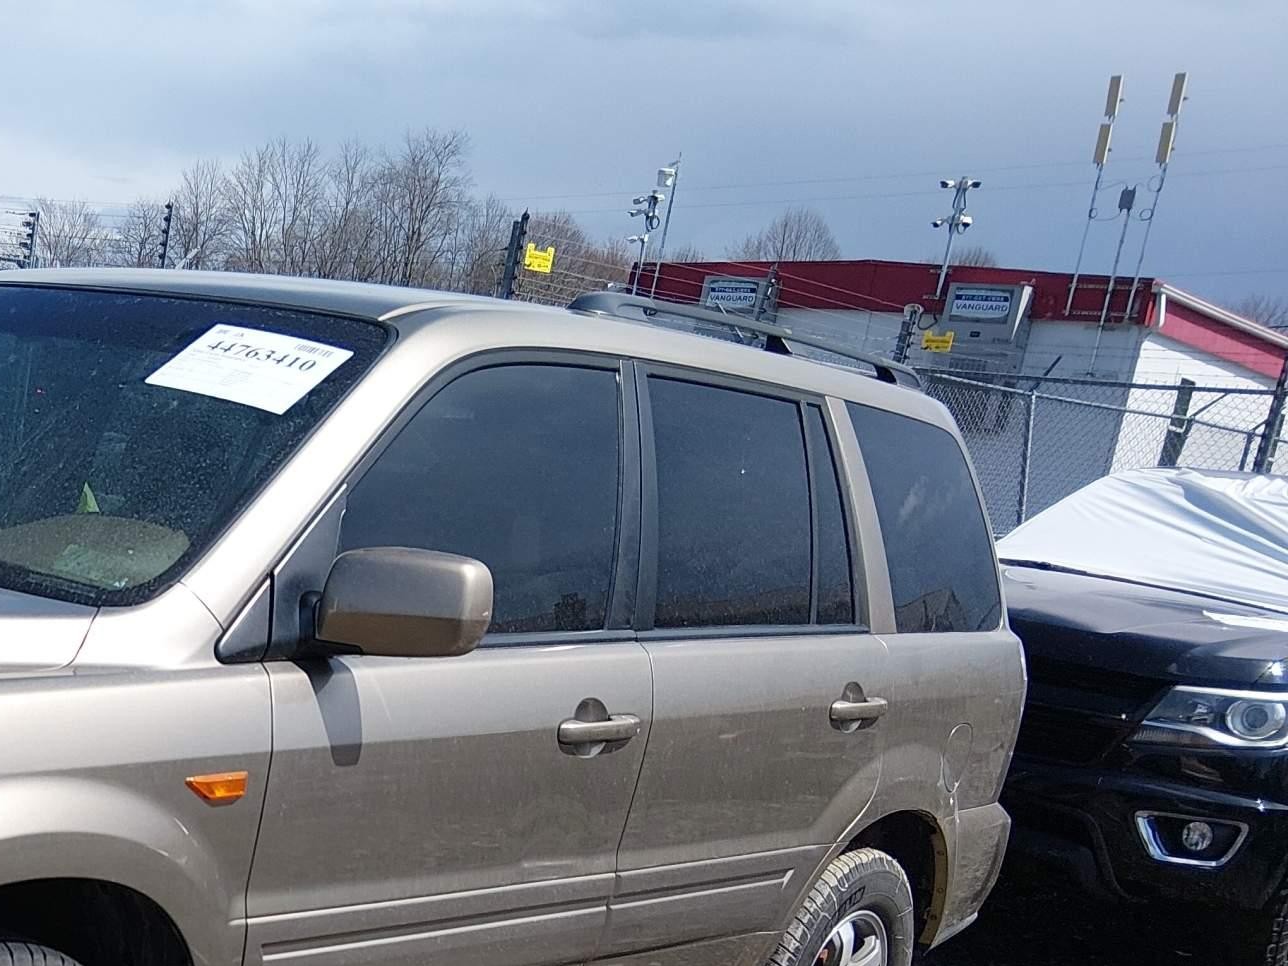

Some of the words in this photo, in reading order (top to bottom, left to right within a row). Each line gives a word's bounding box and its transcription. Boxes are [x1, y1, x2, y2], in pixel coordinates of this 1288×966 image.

[710, 294, 754, 302] VANGUARD
[955, 302, 1008, 312] VANGUARD
[207, 340, 316, 371] 44763410
